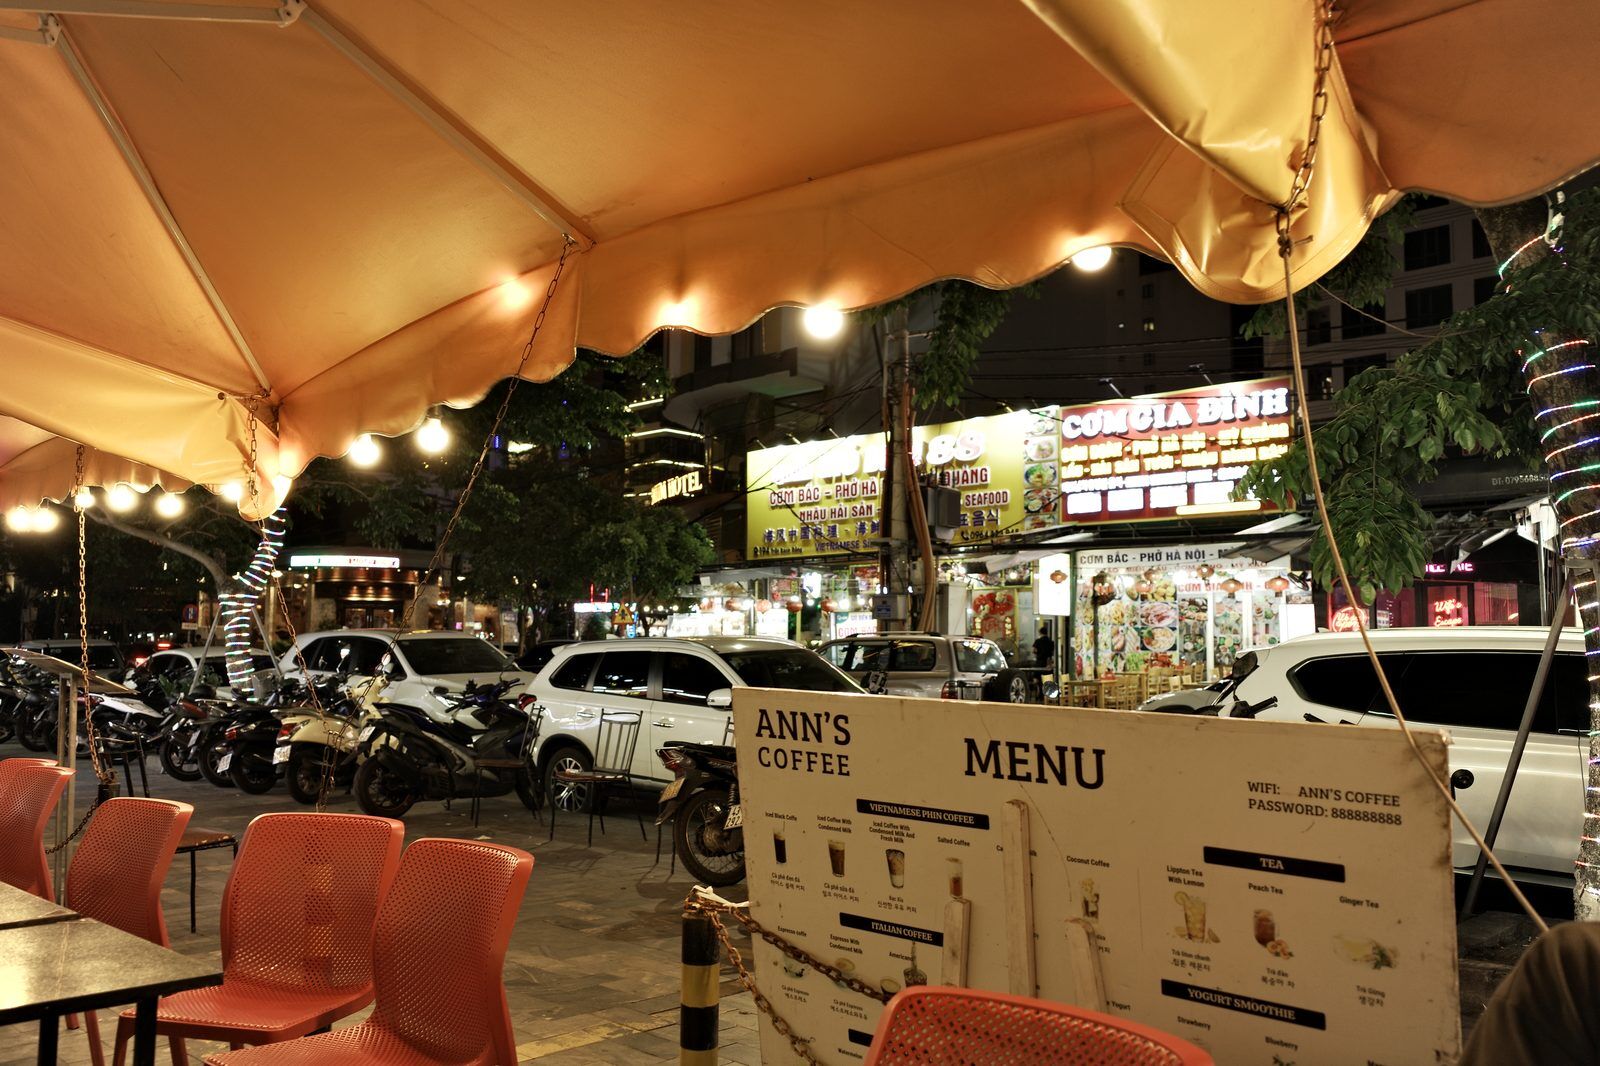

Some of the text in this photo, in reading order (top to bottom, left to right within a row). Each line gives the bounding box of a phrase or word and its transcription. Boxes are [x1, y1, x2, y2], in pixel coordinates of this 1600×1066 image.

[1130, 401, 1193, 433] GIA
[769, 489, 795, 506] CƠM
[964, 490, 1009, 507] SEAFOOD
[830, 503, 848, 519] HẢI
[851, 501, 873, 517] SẢN
[755, 708, 851, 746] ANN'S
[758, 746, 850, 777] COFFEE
[963, 737, 1106, 790] MENU
[1247, 781, 1401, 807] WIFI: ANN'S COFFEE
[869, 803, 975, 824] VIETNAMESE PHIN COFFEE
[1248, 798, 1402, 825] PASSWORD: 888888888
[818, 823, 842, 832] Condensed
[869, 827, 894, 836] Condensed
[880, 834, 893, 842] Fresh
[938, 836, 970, 847] Salted Coffee
[1066, 855, 1110, 868] Coconut Coffee
[1259, 857, 1284, 870] TEA
[1191, 868, 1203, 877] Tea
[1168, 876, 1205, 887] With Lemon
[1248, 882, 1283, 894] Peach Tea
[1339, 895, 1379, 909] Ginger Tea
[871, 921, 933, 941] ITALIAN COFFEE
[889, 951, 913, 962] Americano
[1111, 1000, 1130, 1011] Yogurt
[1187, 988, 1296, 1020] YOGURT SMOOTHIE
[1177, 1016, 1211, 1031] Strawberry
[1265, 1036, 1298, 1051] Blueberry
